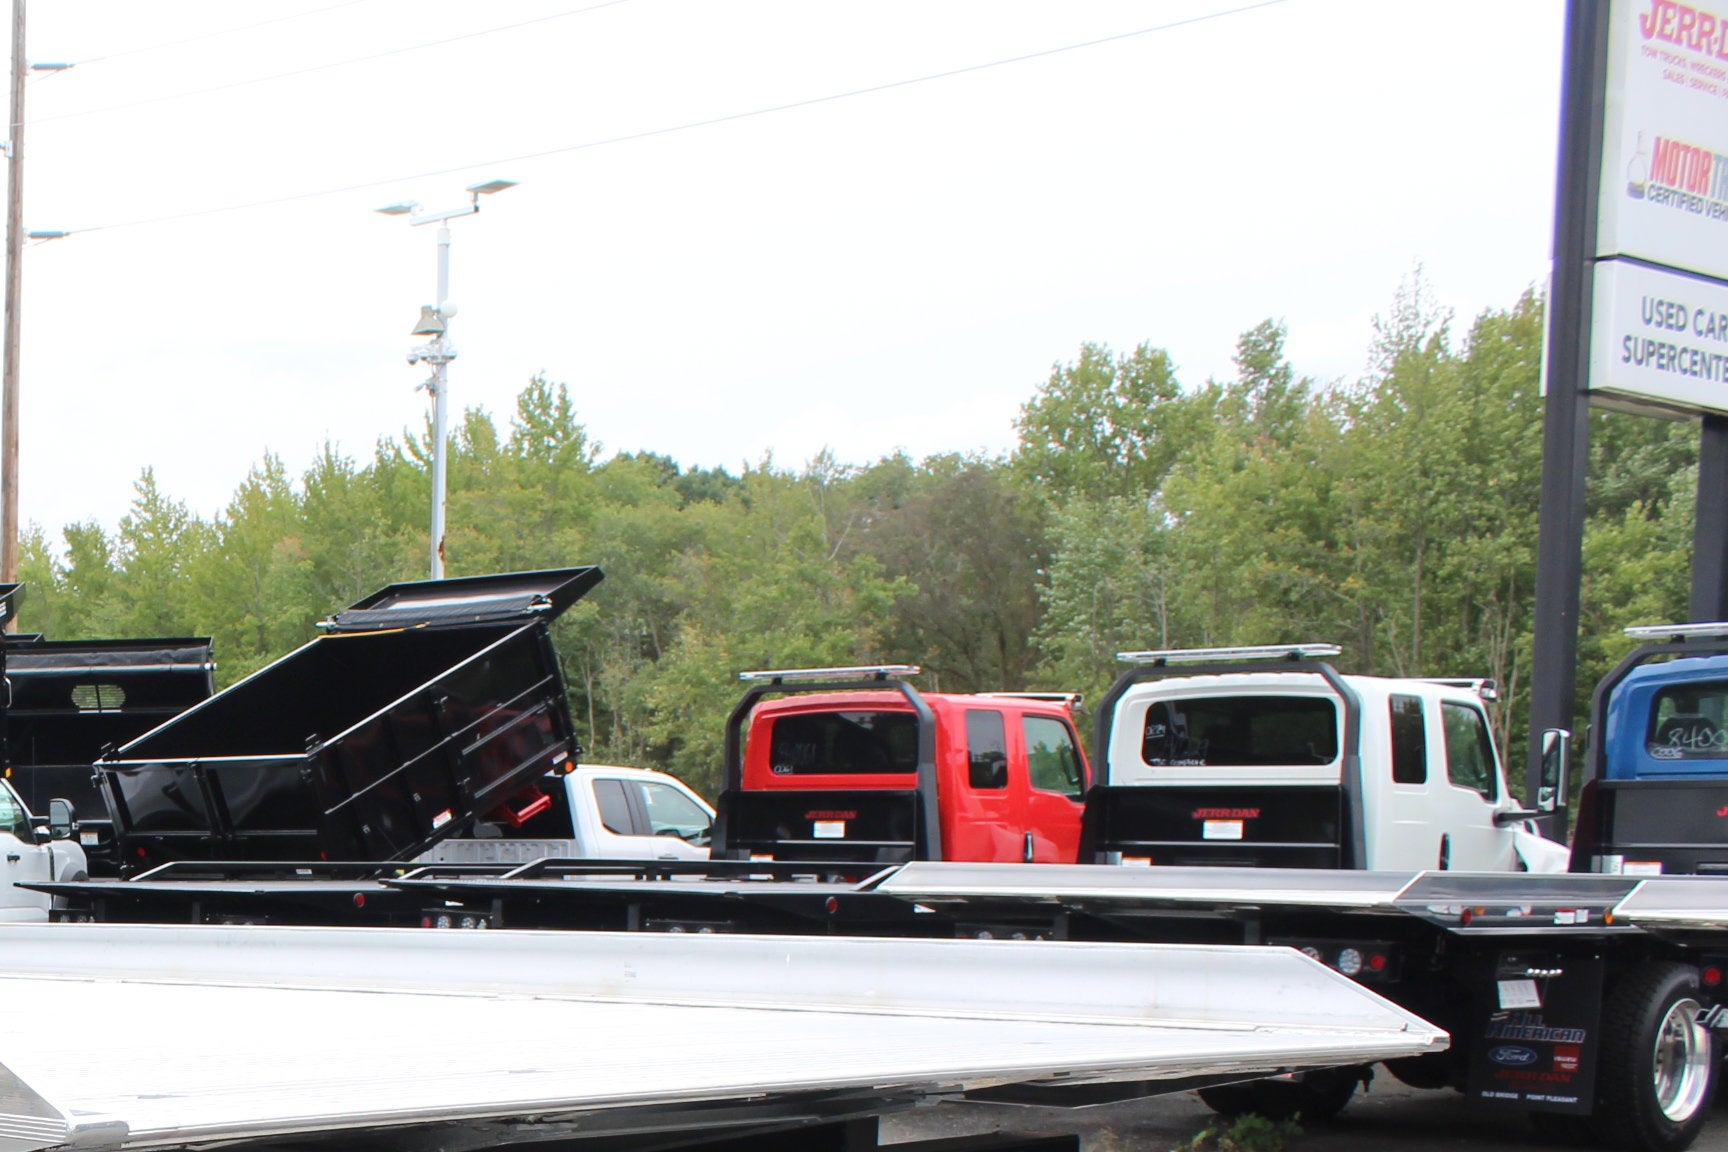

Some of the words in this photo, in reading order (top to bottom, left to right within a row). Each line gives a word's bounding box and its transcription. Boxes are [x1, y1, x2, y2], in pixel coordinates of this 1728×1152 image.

[1647, 183, 1704, 214] CERTIFIED
[1642, 296, 1688, 332] USED
[1693, 308, 1728, 343] CAR
[1622, 334, 1728, 384] SUPERCENTE
